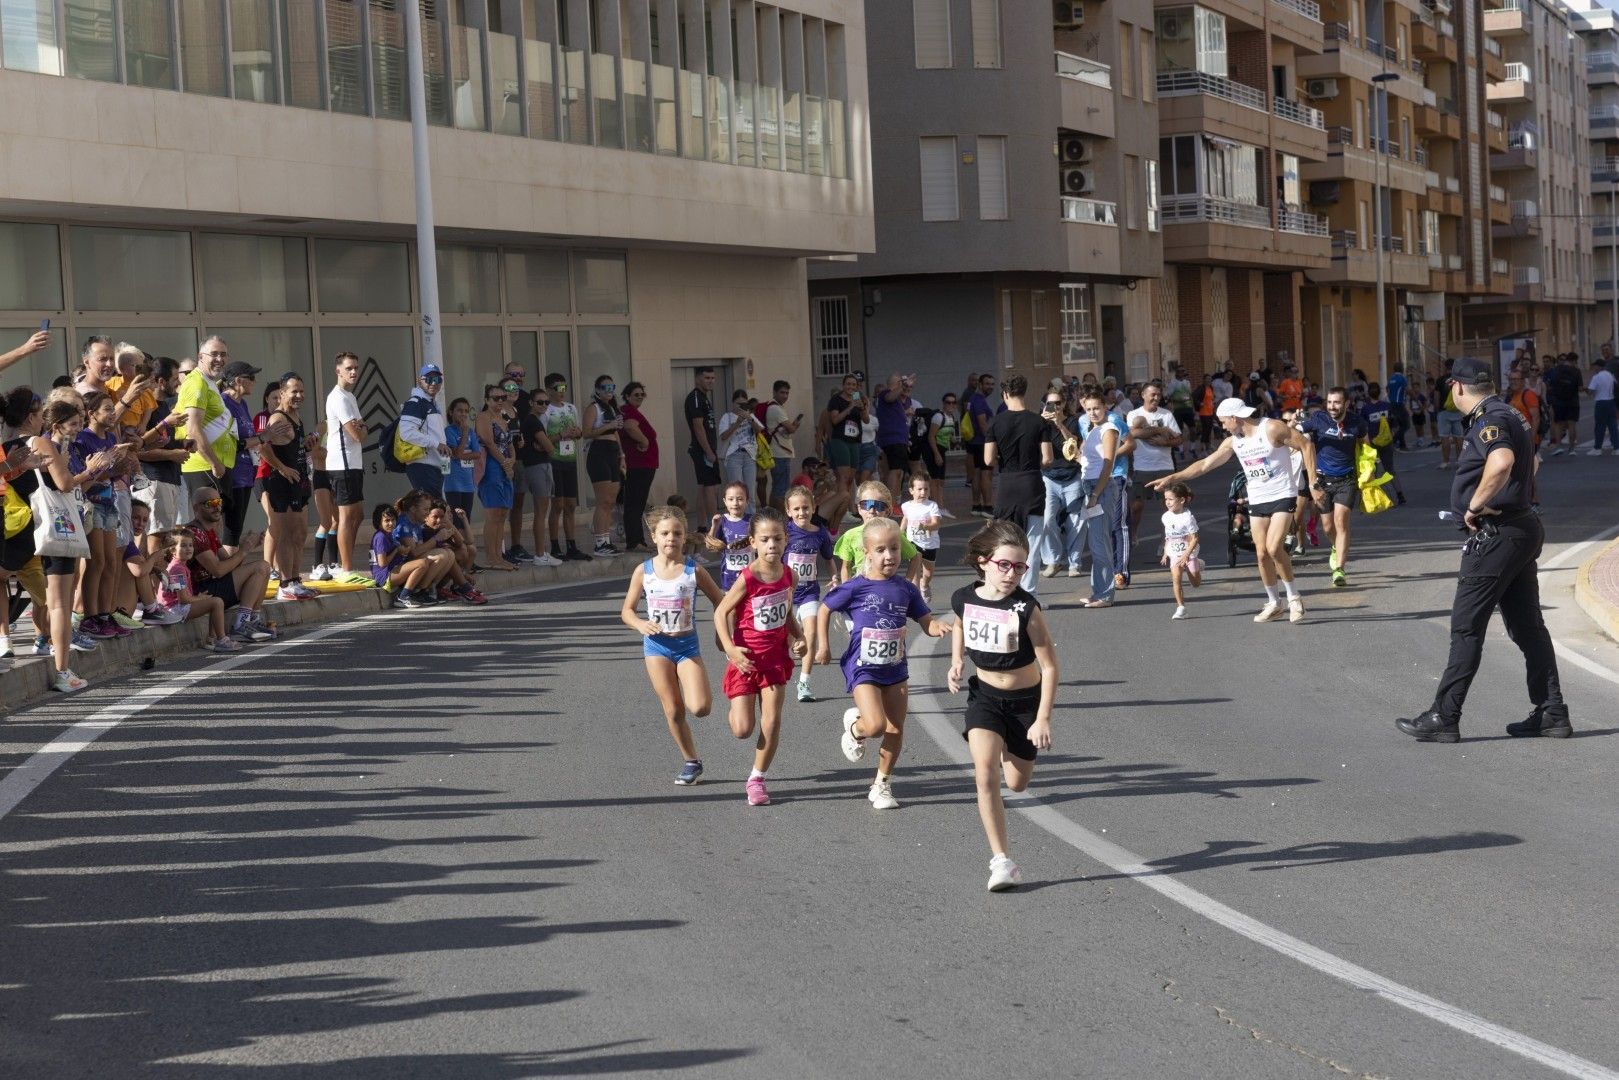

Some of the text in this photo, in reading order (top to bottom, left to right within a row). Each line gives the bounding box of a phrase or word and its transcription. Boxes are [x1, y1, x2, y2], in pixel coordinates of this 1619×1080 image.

[1249, 468, 1266, 478] 203
[729, 553, 750, 566] 529
[792, 562, 813, 577] 500
[652, 609, 682, 625] 517
[760, 602, 787, 625] 530
[968, 620, 1000, 645] 541
[867, 640, 898, 658] 528
